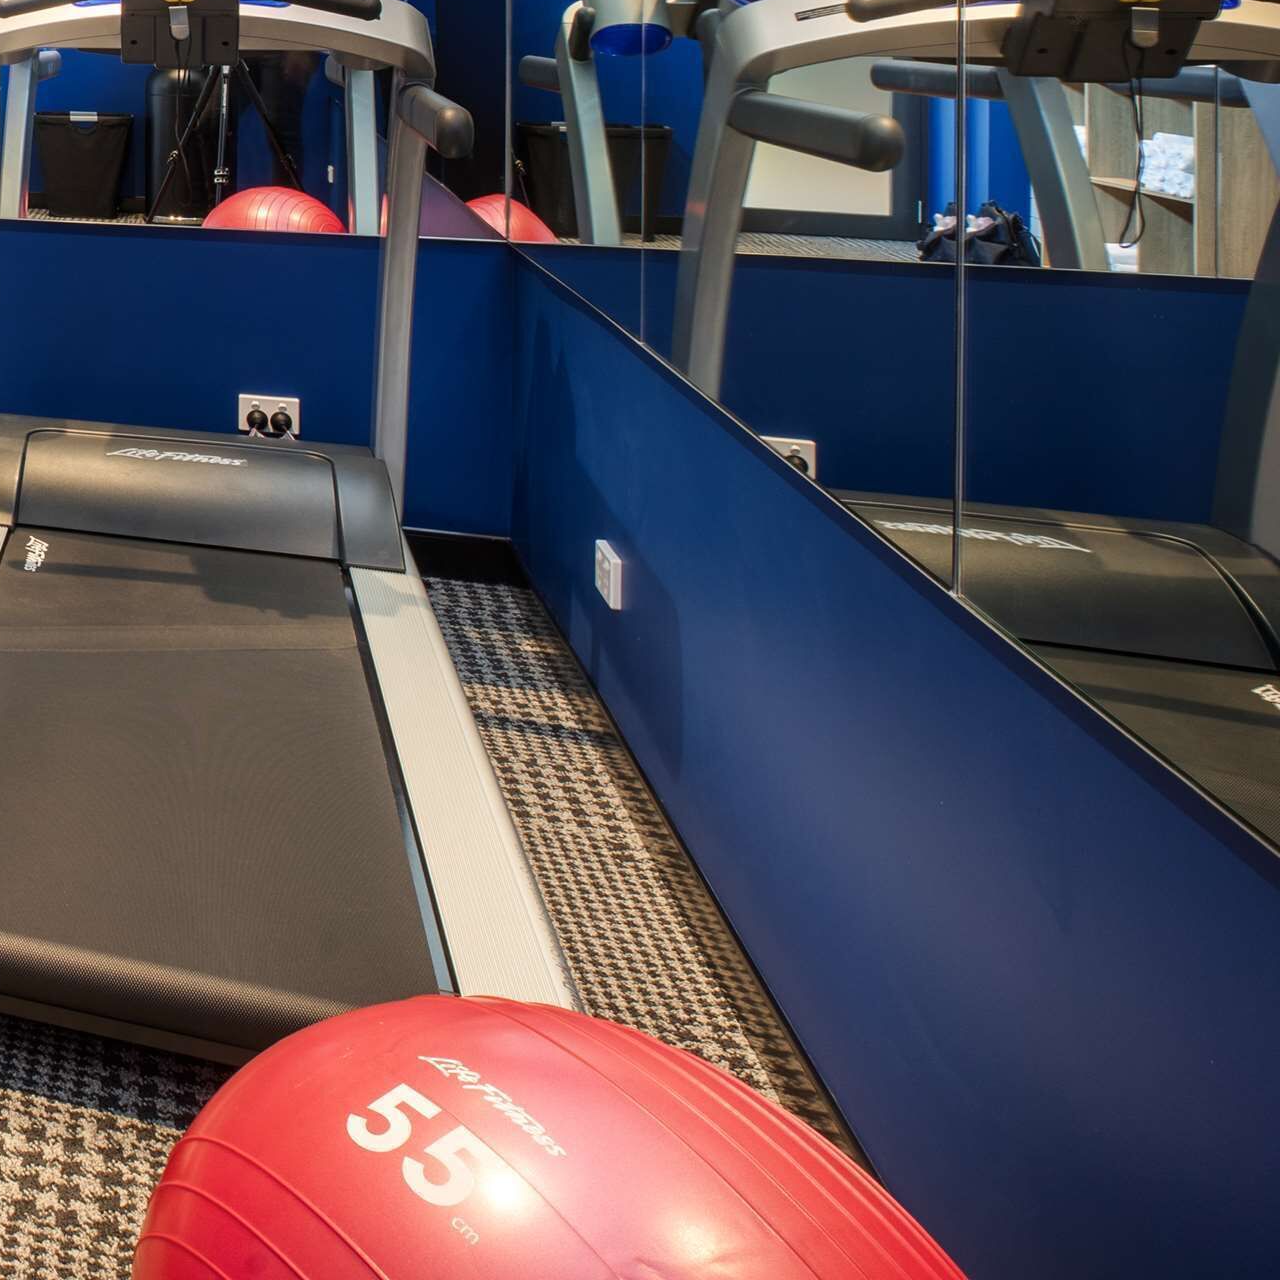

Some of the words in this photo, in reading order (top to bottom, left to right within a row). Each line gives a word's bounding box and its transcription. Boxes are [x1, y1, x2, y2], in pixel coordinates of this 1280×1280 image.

[346, 1083, 510, 1207] 55
[417, 1055, 481, 1084] Life
[461, 1082, 569, 1158] Fitness
[451, 1216, 481, 1246] cm
